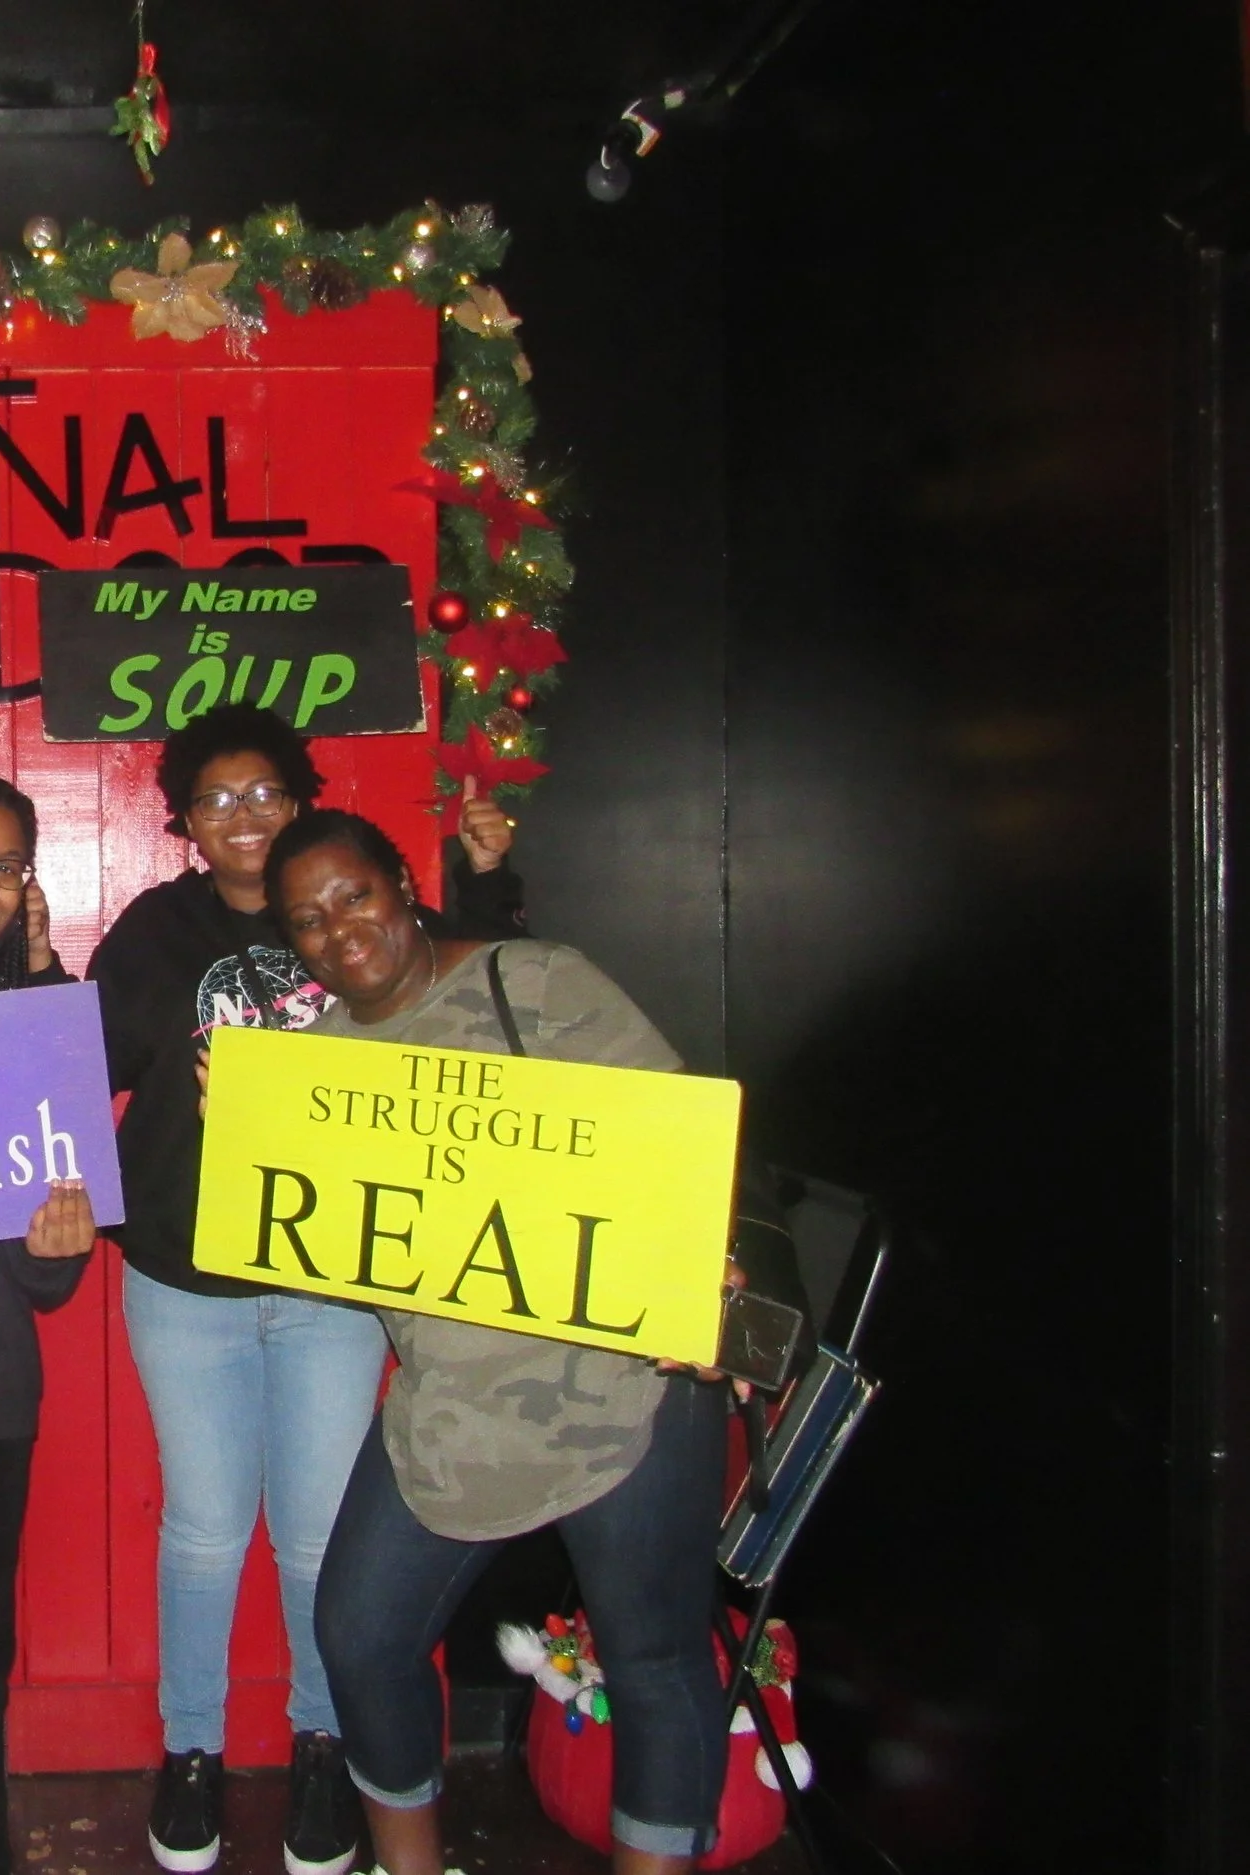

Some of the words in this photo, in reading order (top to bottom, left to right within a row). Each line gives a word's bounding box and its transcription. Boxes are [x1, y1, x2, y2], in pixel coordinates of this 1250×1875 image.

[94, 582, 168, 621] My
[180, 582, 317, 613] Name
[188, 624, 230, 654] is
[98, 654, 356, 733] SOUP
[401, 1053, 504, 1101] THE
[310, 1086, 597, 1158] STRUGGLE
[423, 1143, 466, 1184] IS
[245, 1163, 648, 1338] REAL
